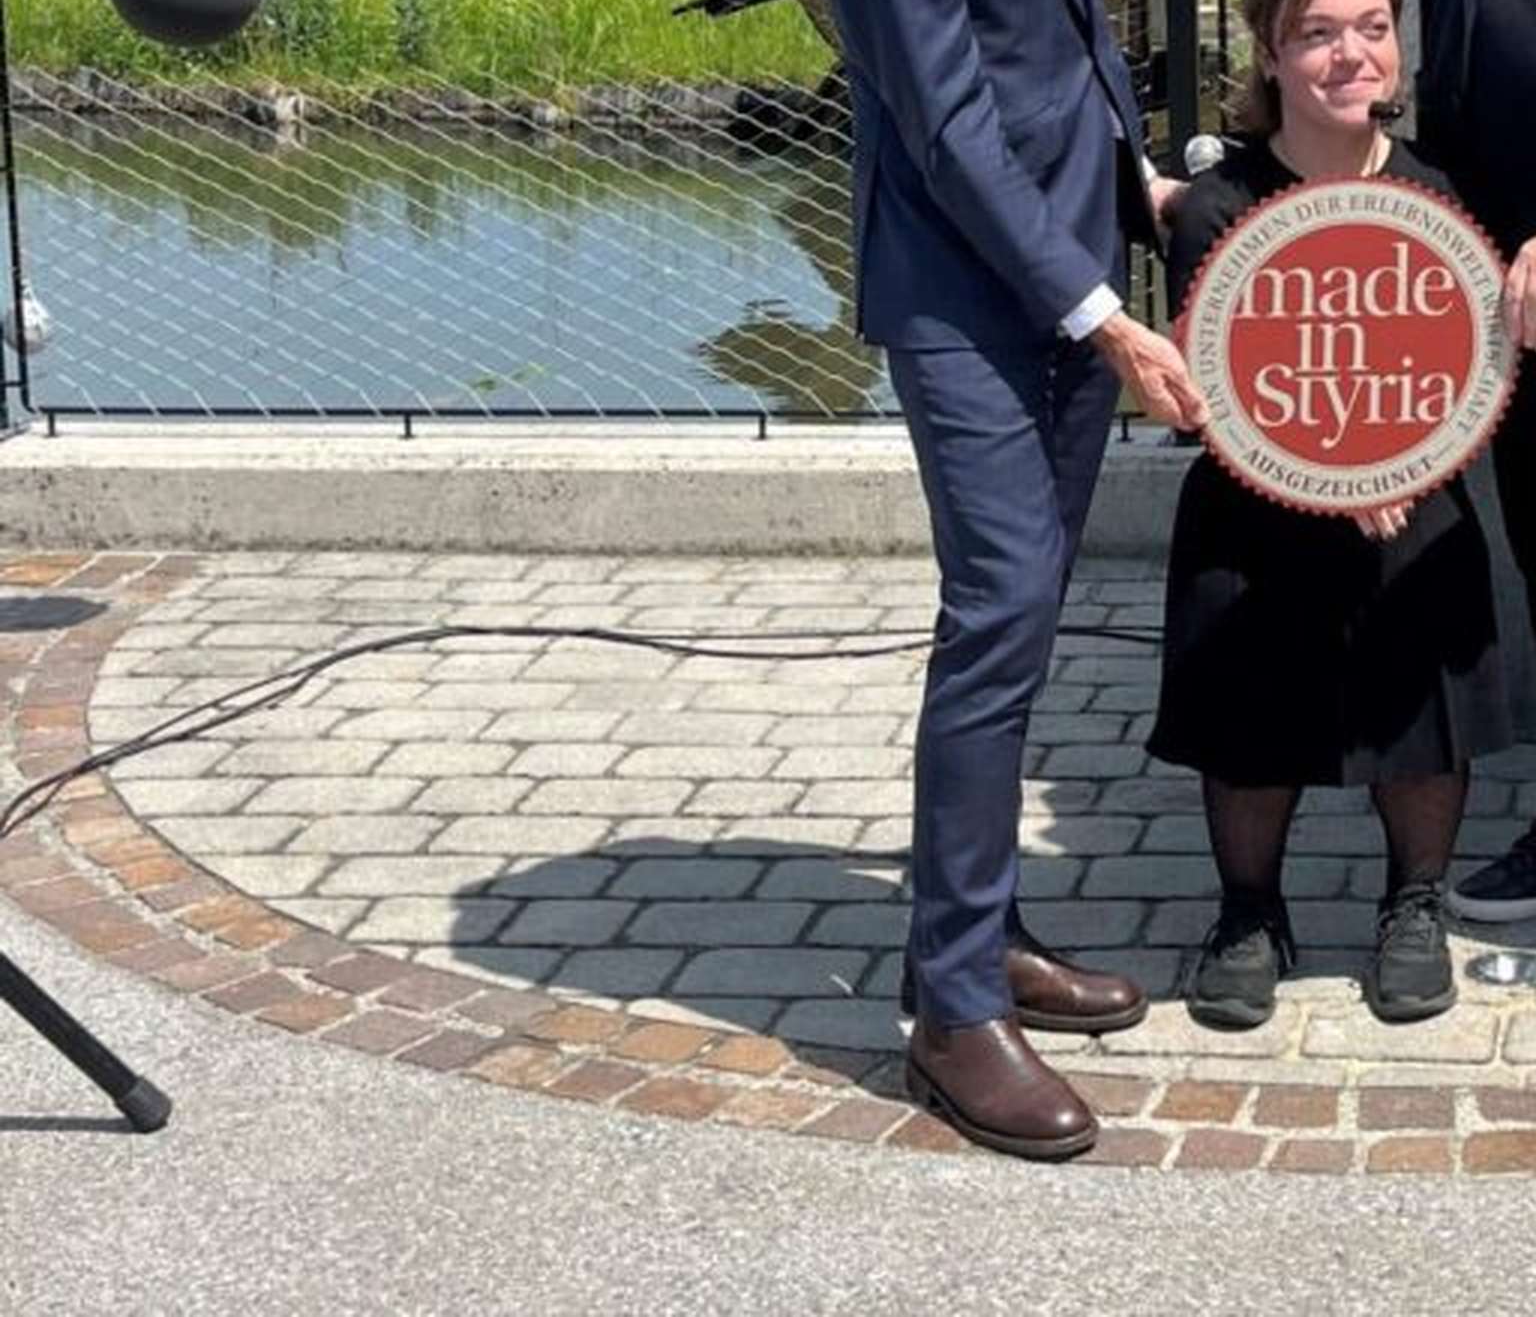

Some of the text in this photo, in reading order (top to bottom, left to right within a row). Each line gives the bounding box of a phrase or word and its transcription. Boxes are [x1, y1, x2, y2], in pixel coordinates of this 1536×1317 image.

[1199, 211, 1288, 375] UNTERNEHMEN
[1293, 197, 1341, 221] DER
[1349, 194, 1490, 287] ERLEBNISWELT
[1229, 242, 1454, 319] made
[1296, 321, 1371, 372] in
[1243, 449, 1435, 496] AUSGEZEICHNET
